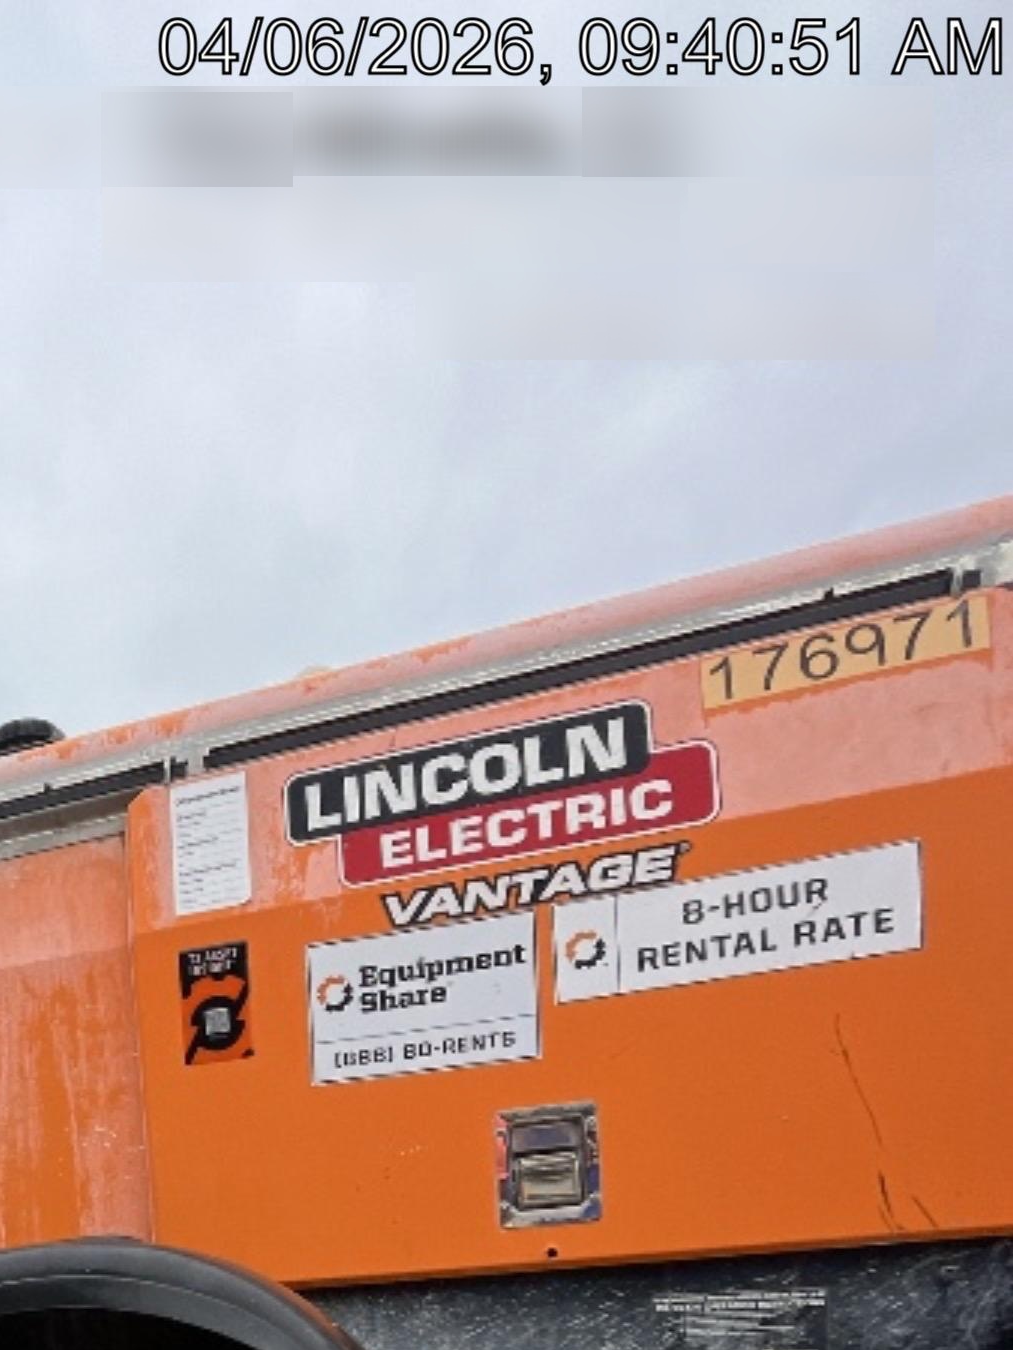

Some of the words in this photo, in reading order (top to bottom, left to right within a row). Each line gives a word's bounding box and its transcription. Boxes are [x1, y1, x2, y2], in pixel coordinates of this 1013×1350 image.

[709, 599, 973, 700] 176971
[305, 715, 628, 833] LINCOLN
[379, 778, 673, 869] ELECTRIC
[383, 844, 678, 926] VANTAGE
[682, 877, 829, 925] 8-HOUR
[358, 944, 526, 989] Equipment
[636, 927, 778, 973] RENTAL
[792, 907, 895, 948] RATE
[359, 984, 448, 1014] Share
[403, 1031, 517, 1061] 80-RENTS
